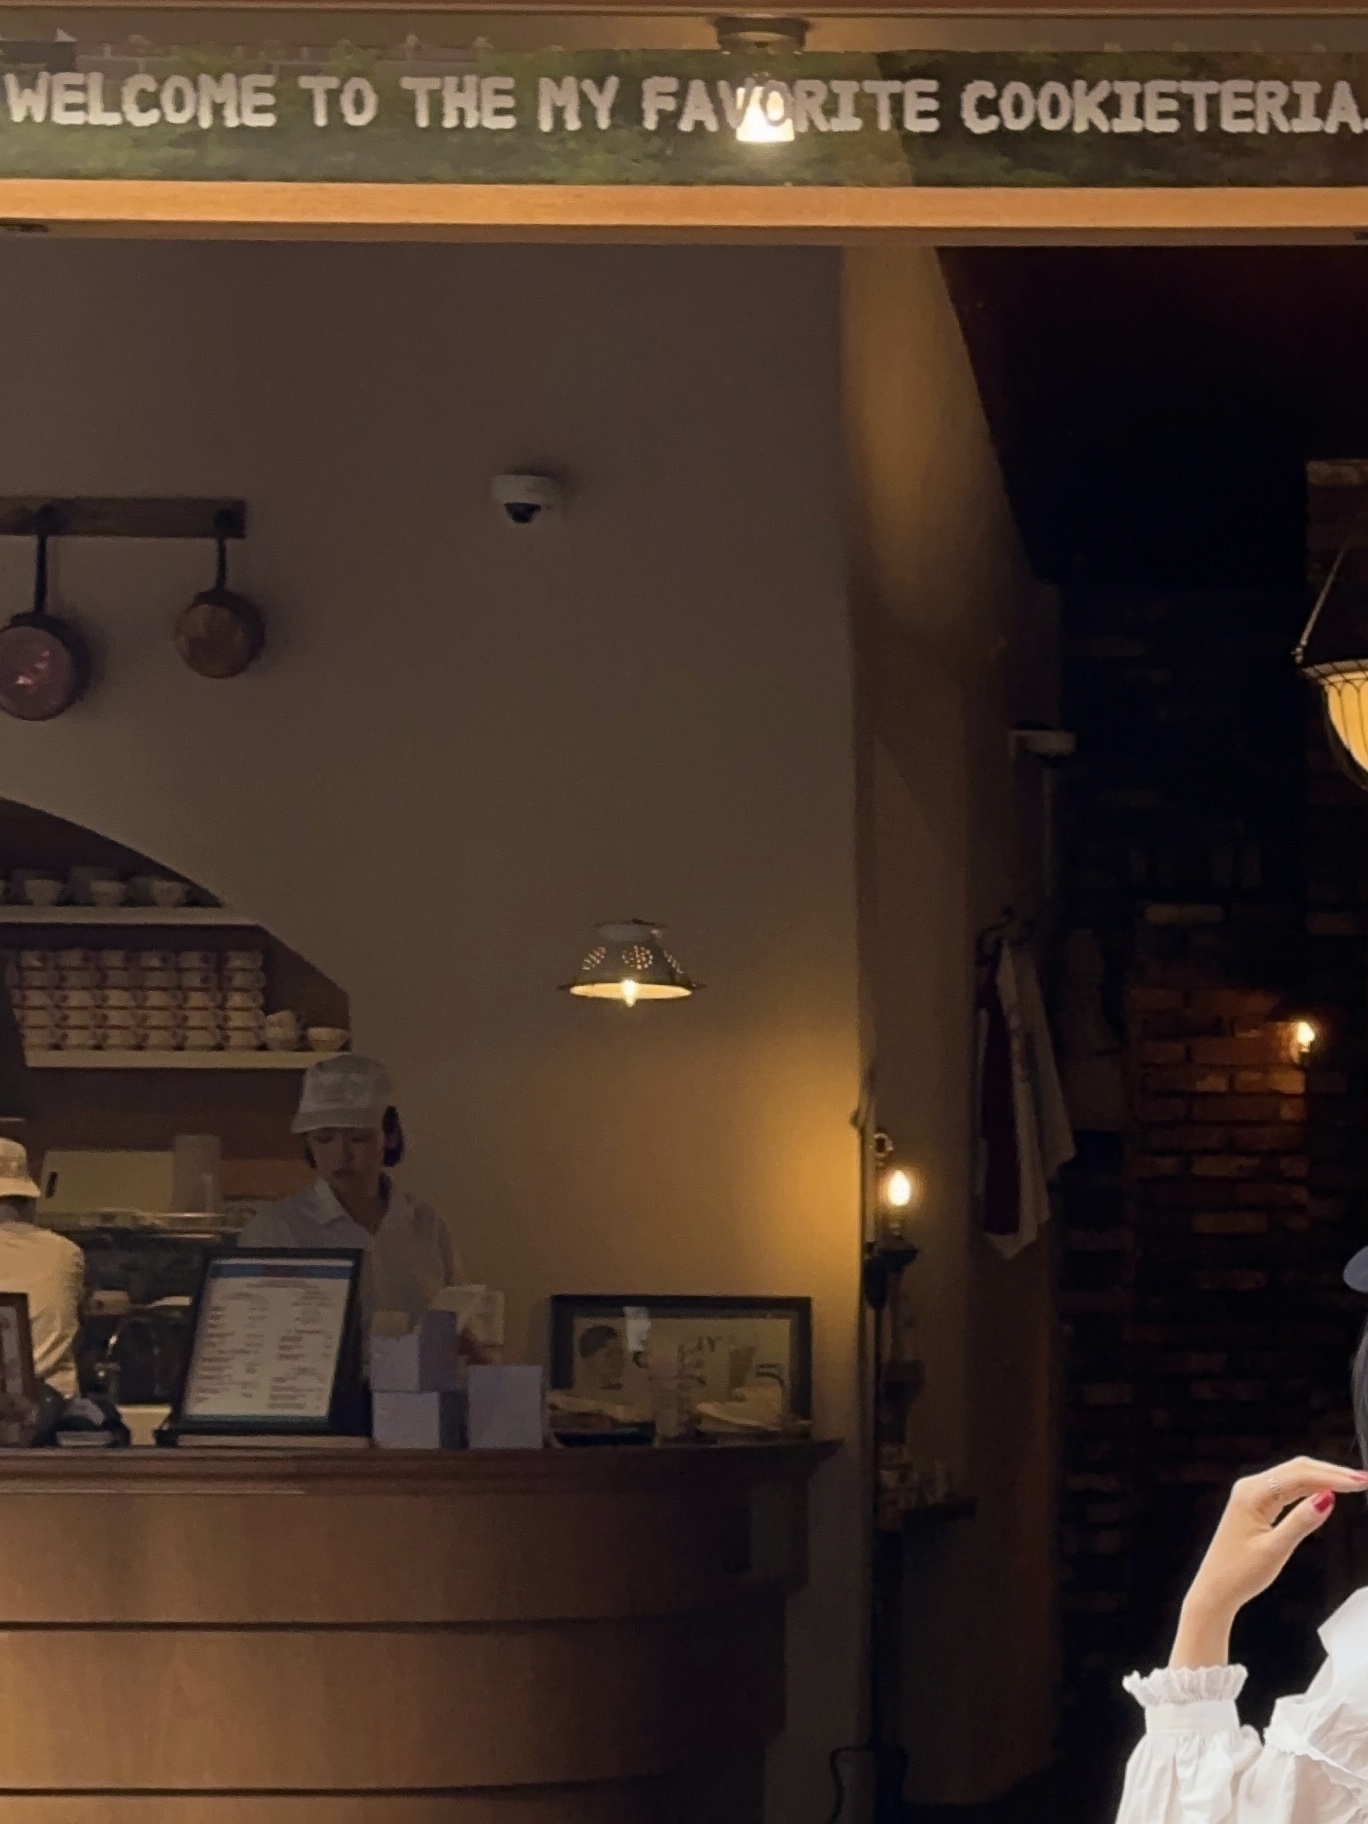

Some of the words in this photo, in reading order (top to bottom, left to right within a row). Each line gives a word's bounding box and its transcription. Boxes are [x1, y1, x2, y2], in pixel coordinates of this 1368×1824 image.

[3, 71, 277, 128] WELCOME
[299, 75, 379, 128] TO
[400, 75, 517, 129] THE
[538, 75, 621, 132] MY
[641, 76, 941, 133] FAVORITE
